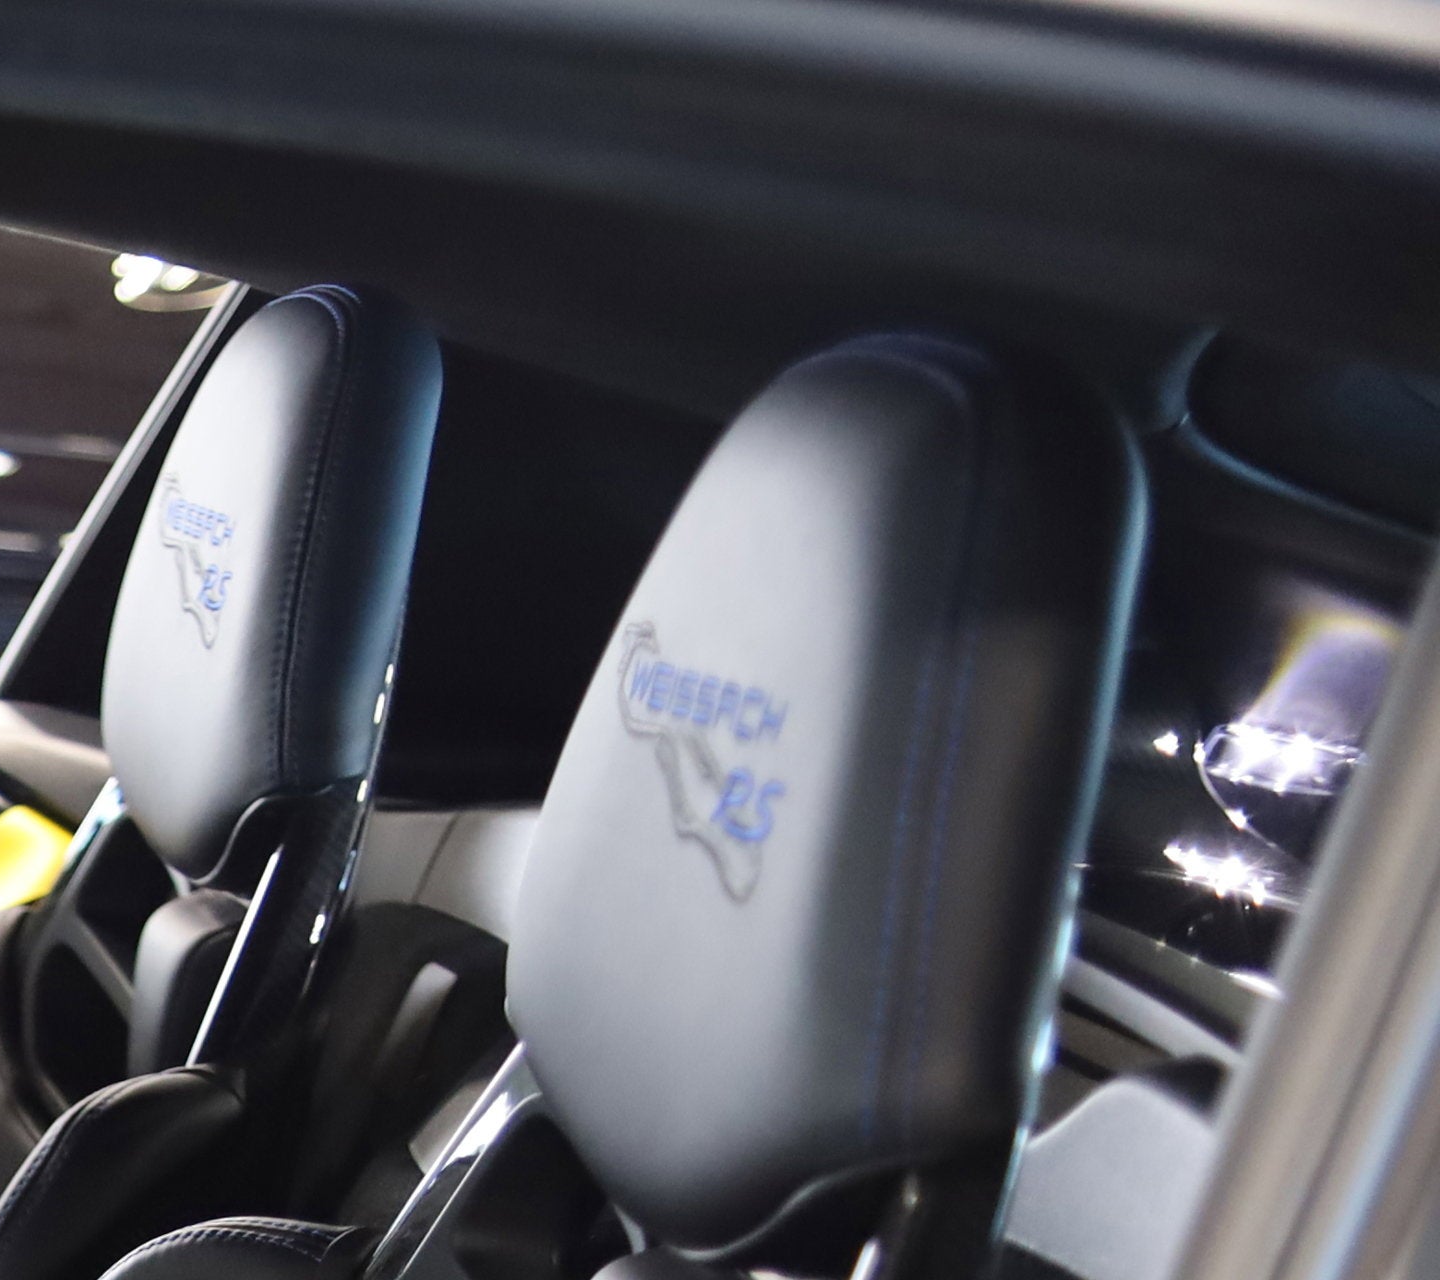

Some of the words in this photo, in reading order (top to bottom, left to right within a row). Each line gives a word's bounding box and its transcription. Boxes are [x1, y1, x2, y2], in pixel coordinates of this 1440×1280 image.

[198, 563, 234, 611] RS
[629, 659, 790, 741] WEISSACH
[710, 767, 787, 843] RS
